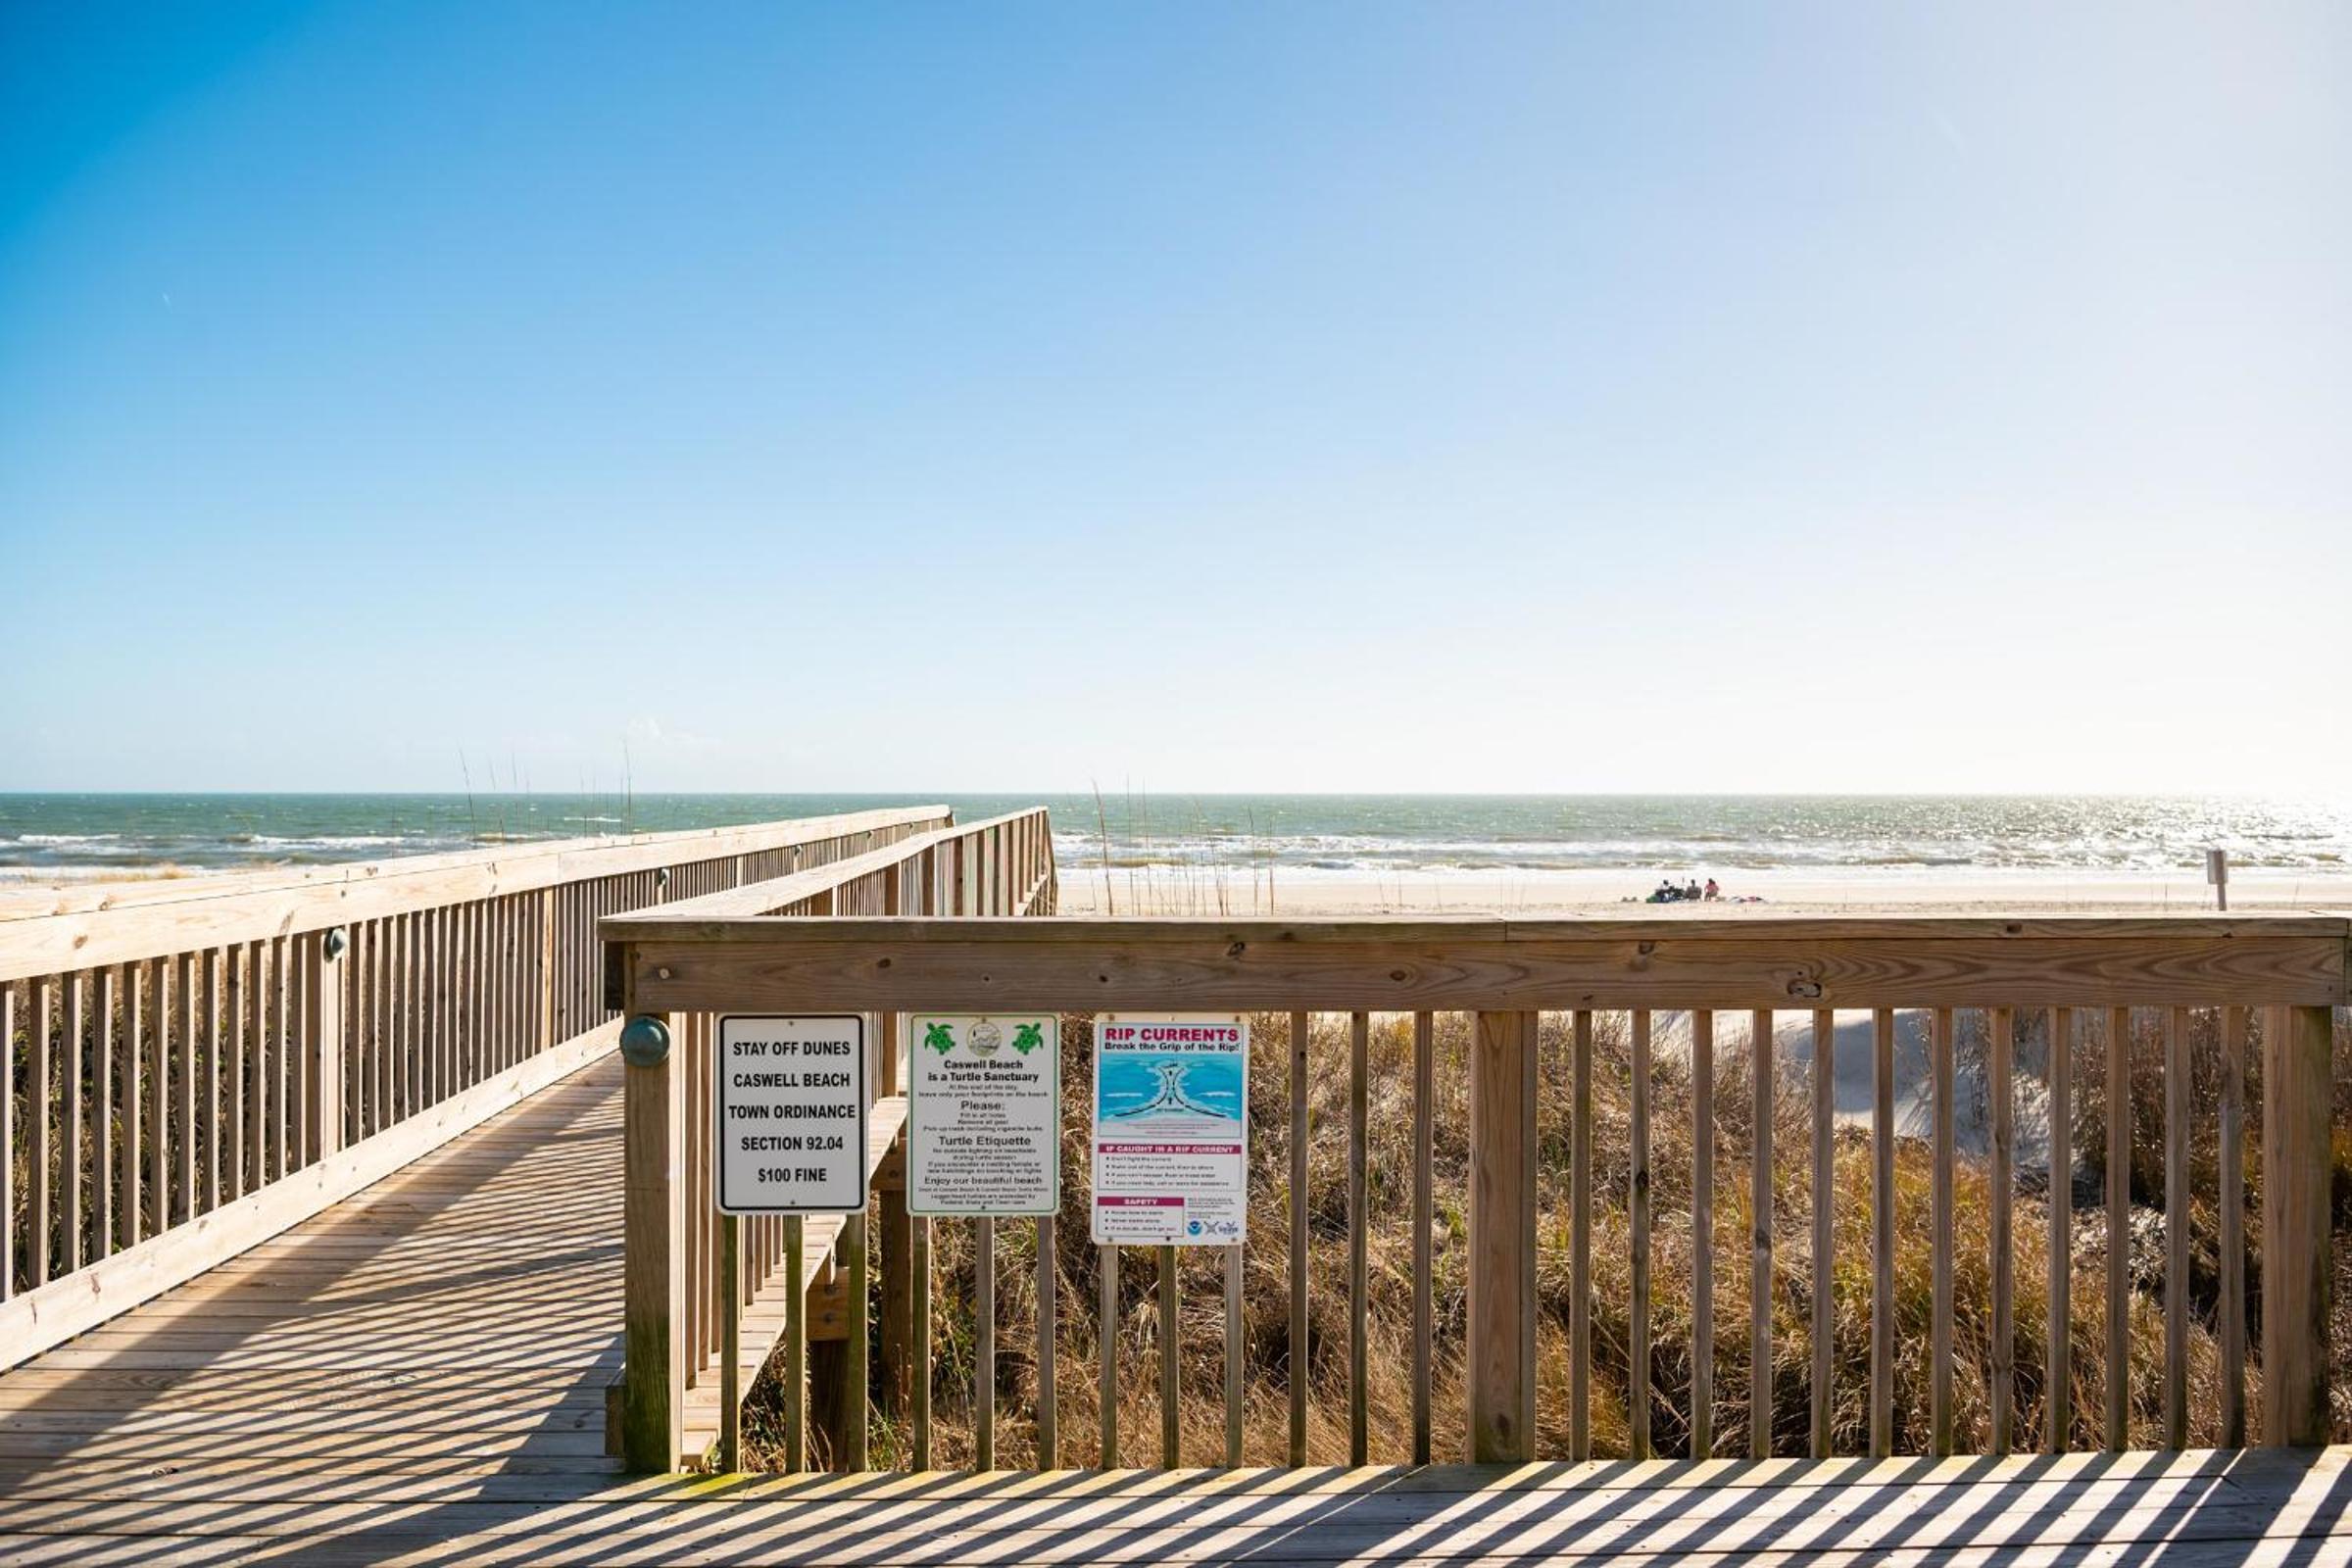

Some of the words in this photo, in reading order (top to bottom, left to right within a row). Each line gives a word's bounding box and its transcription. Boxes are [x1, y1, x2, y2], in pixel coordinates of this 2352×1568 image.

[1105, 1028, 1136, 1041] RIP
[1141, 1028, 1239, 1042] CURRENTS
[733, 1042, 767, 1056] STAY
[772, 1042, 799, 1056] OFF
[804, 1042, 851, 1056] DUNES
[1159, 1043, 1181, 1052] Grip
[944, 1060, 986, 1069] Caswell
[989, 1060, 1023, 1069] Beach
[733, 1073, 799, 1088] CASWELL
[804, 1073, 851, 1088] BEACH
[928, 1072, 938, 1082] is
[950, 1072, 981, 1082] Turtle
[984, 1072, 1039, 1083] Sanctuary
[729, 1105, 769, 1119] TOWN
[774, 1105, 856, 1119] ORDINANCE
[741, 1137, 802, 1151] SECTION
[807, 1137, 843, 1151] 92.04
[939, 1137, 973, 1146] Turtle
[976, 1137, 1031, 1147] Etiquette
[759, 1168, 791, 1183] $100
[795, 1168, 827, 1183] FINE
[924, 1177, 951, 1186] Enjoy
[972, 1176, 1012, 1185] beautiful
